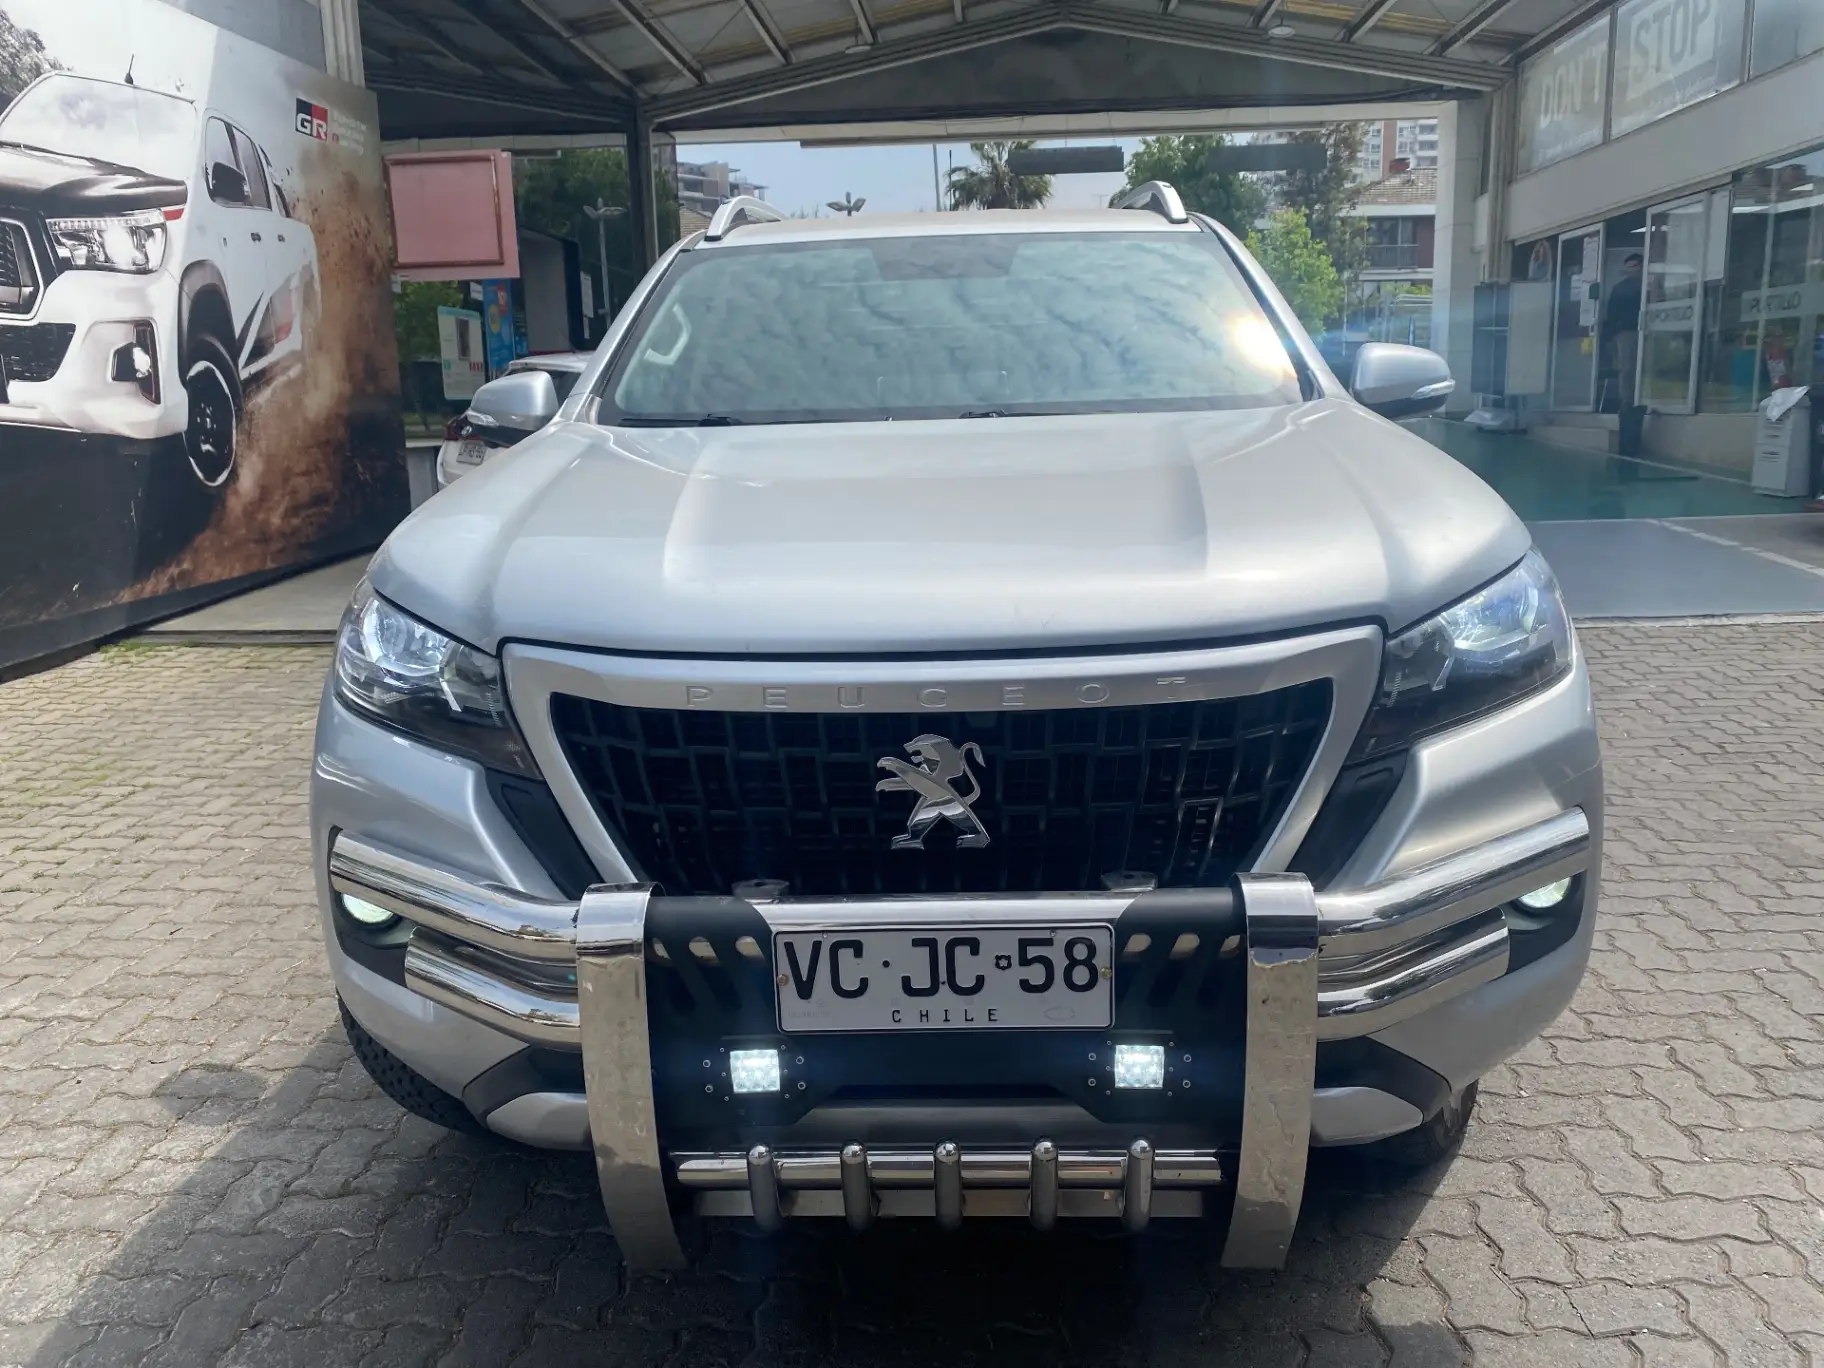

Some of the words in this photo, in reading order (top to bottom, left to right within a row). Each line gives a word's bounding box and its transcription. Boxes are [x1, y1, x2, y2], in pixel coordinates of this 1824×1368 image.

[1632, 0, 1711, 83] STOP
[296, 112, 328, 141] GR
[685, 676, 1187, 709] PEUGEOT
[891, 1008, 998, 1023] CHILE
